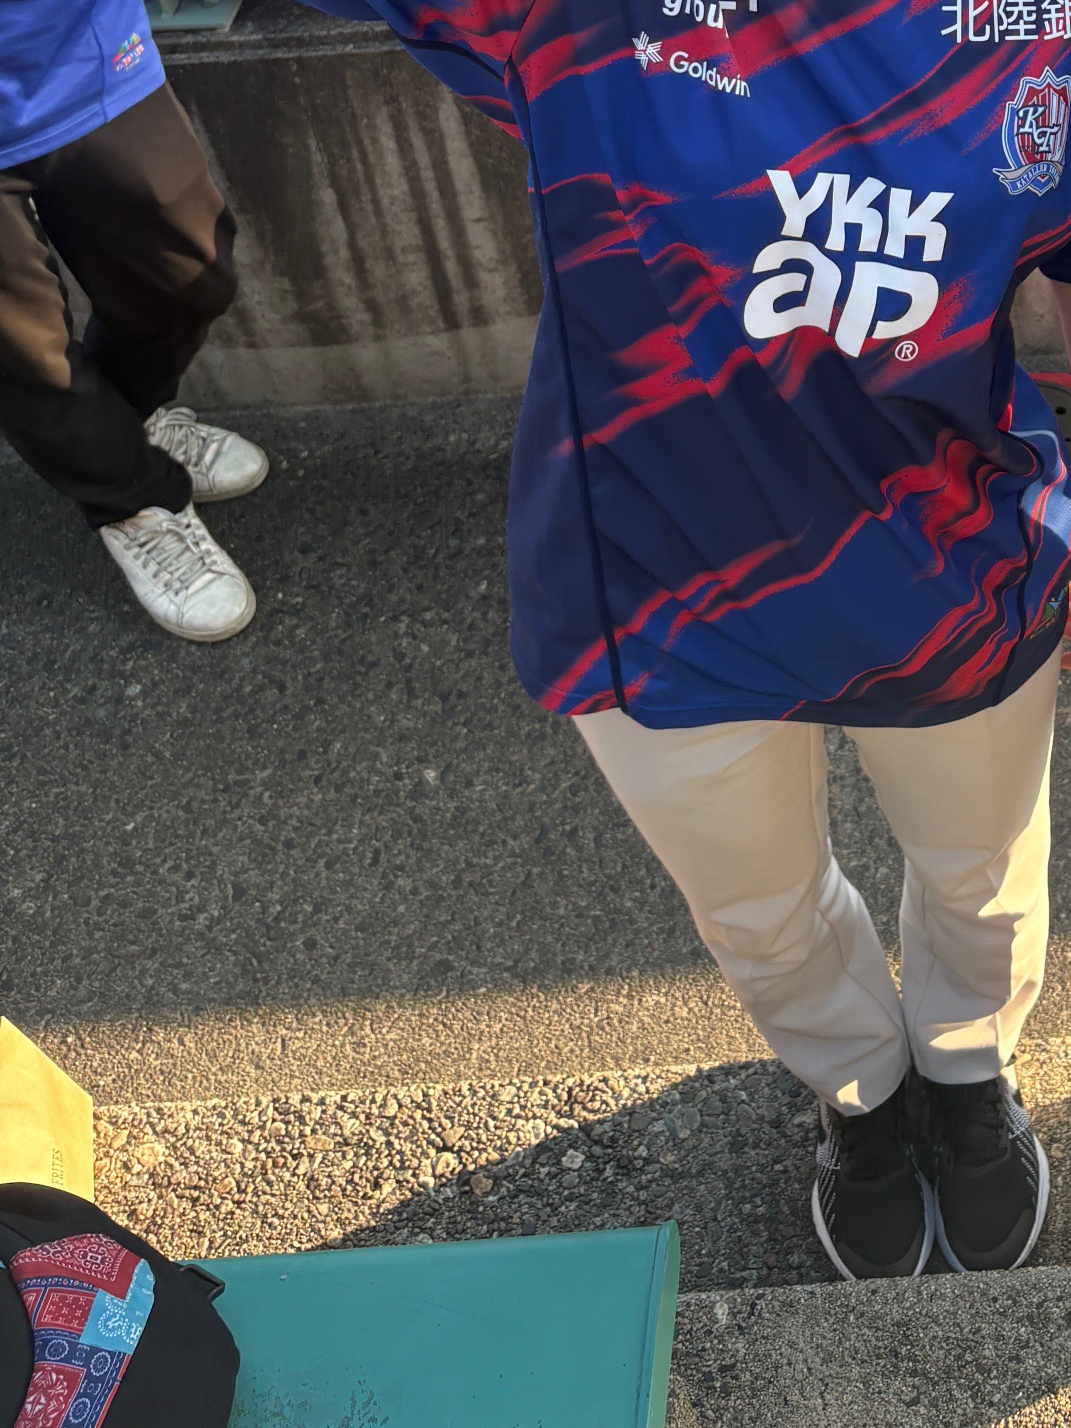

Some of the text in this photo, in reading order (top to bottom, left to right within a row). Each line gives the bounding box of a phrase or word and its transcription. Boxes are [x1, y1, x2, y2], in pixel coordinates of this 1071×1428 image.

[669, 51, 751, 99] Goldwin
[765, 169, 955, 263] YKK
[743, 239, 940, 358] ap
